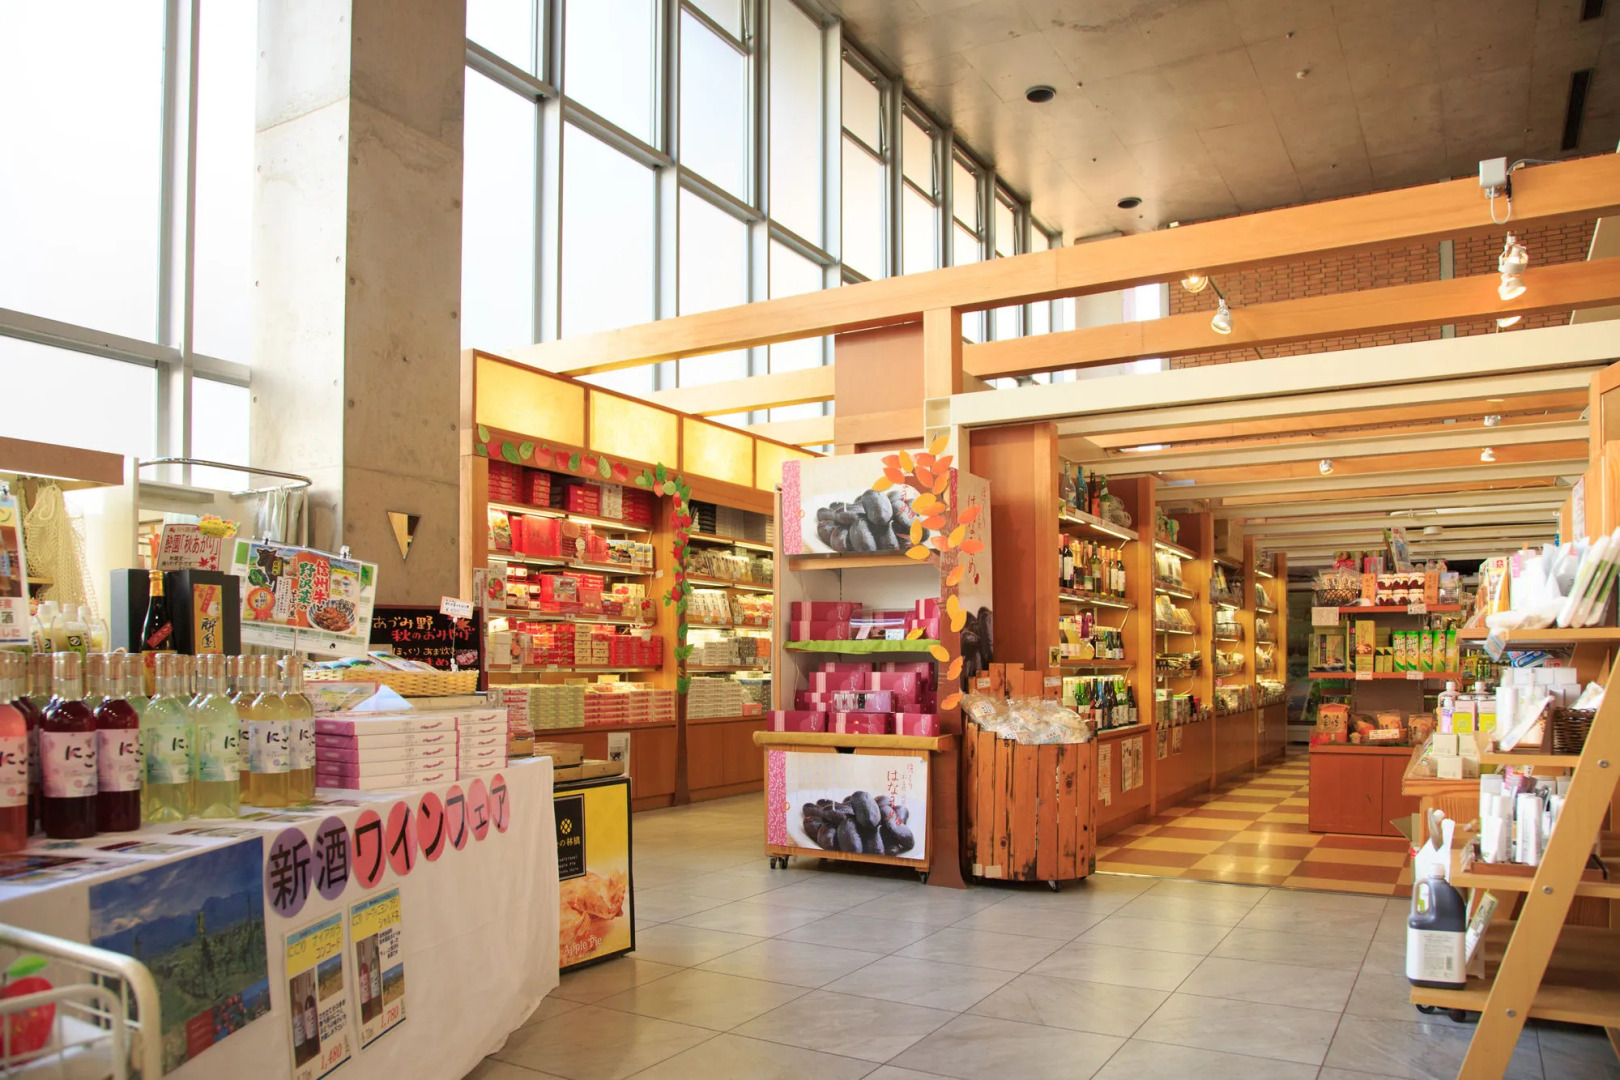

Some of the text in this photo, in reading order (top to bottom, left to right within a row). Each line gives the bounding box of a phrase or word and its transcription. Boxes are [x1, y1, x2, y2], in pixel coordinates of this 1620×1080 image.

[298, 562, 316, 610] 野沢菜の
[313, 560, 330, 612] 信州牛と
[372, 615, 434, 631] あづみ野
[390, 627, 476, 642] 秋のおみやげ
[270, 784, 507, 910] 新酒ワインフェア
[564, 940, 588, 956] Apple
[589, 936, 602, 947] Pie
